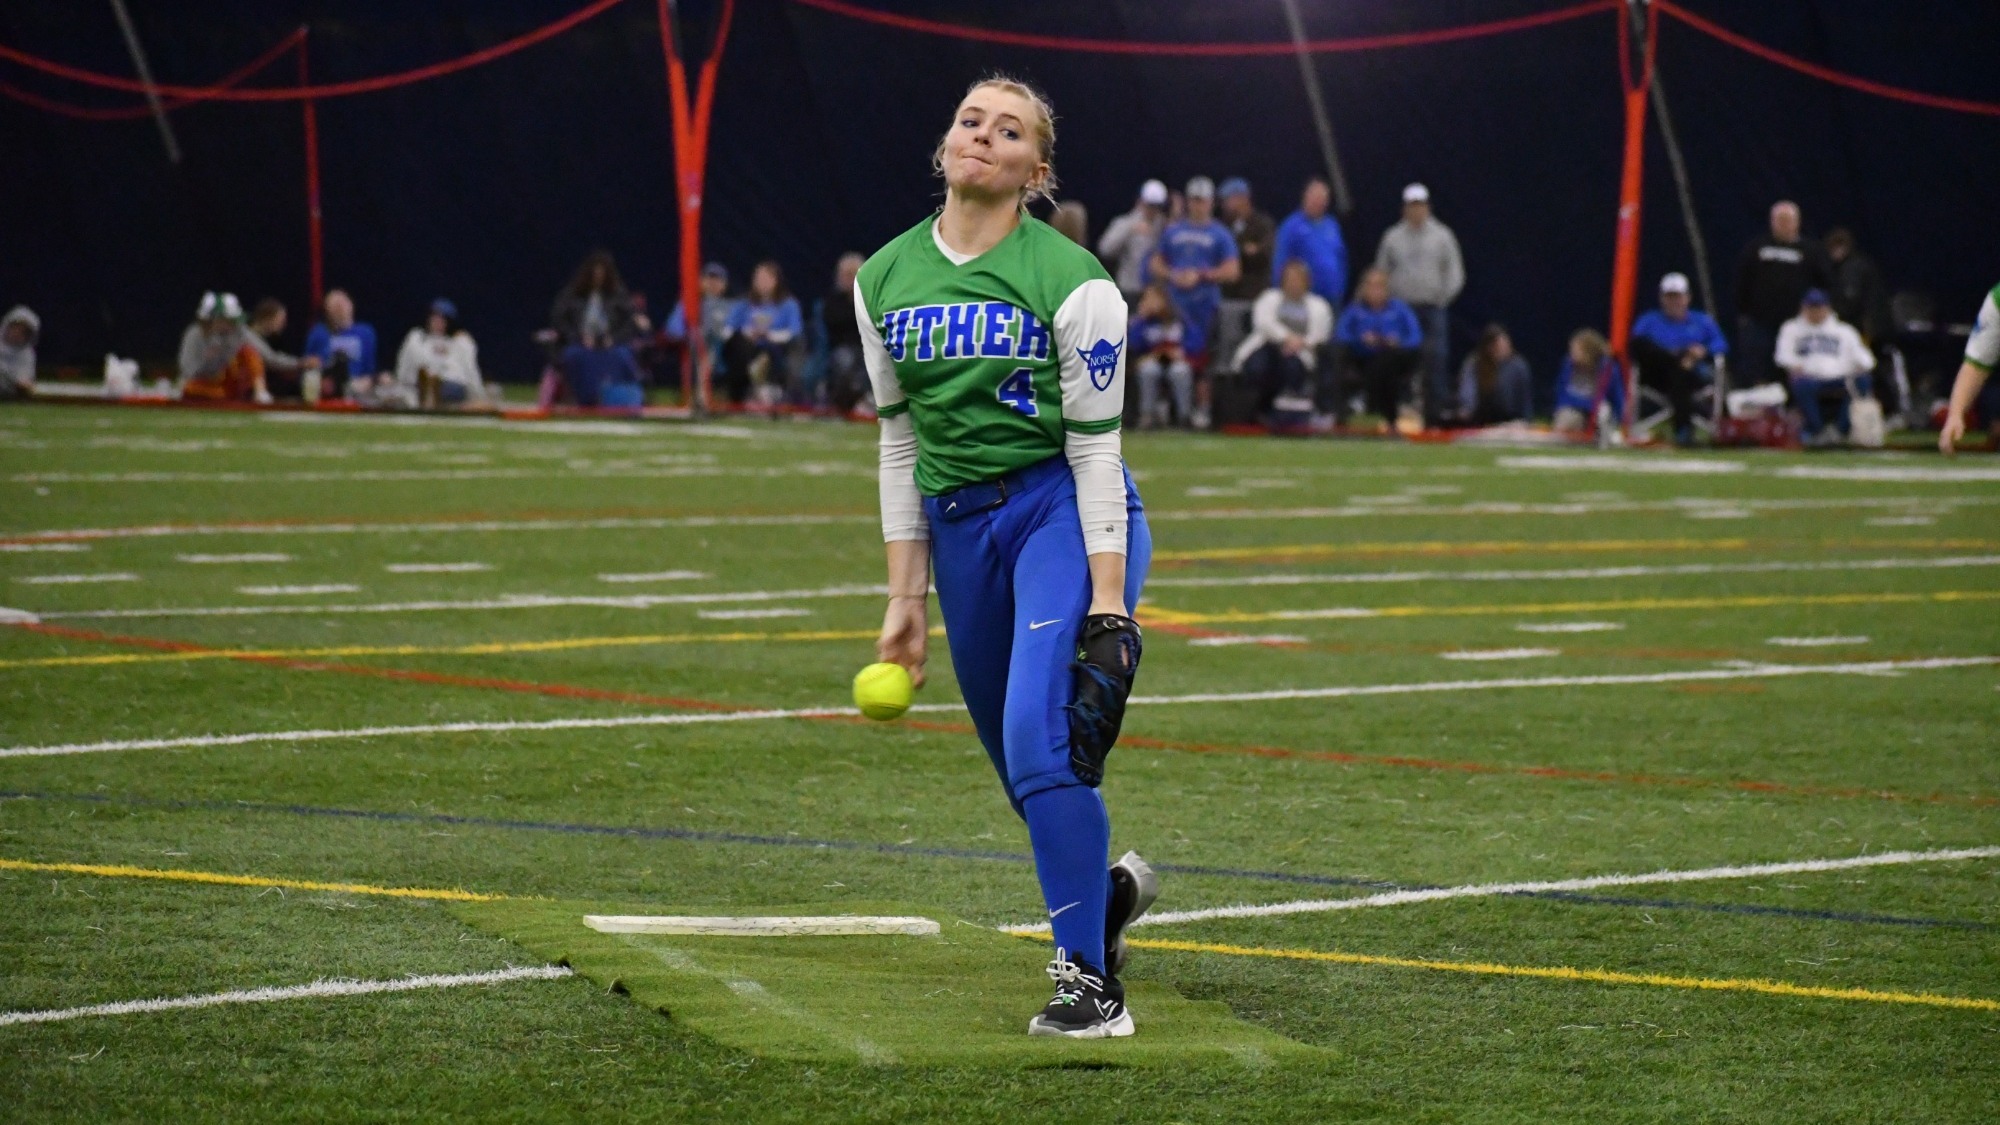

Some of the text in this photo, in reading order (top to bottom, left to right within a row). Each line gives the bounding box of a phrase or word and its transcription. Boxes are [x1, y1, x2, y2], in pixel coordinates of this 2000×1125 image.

[877, 301, 1049, 362] UTHER
[1090, 353, 1116, 366] NORSE
[996, 367, 1039, 417] 4
